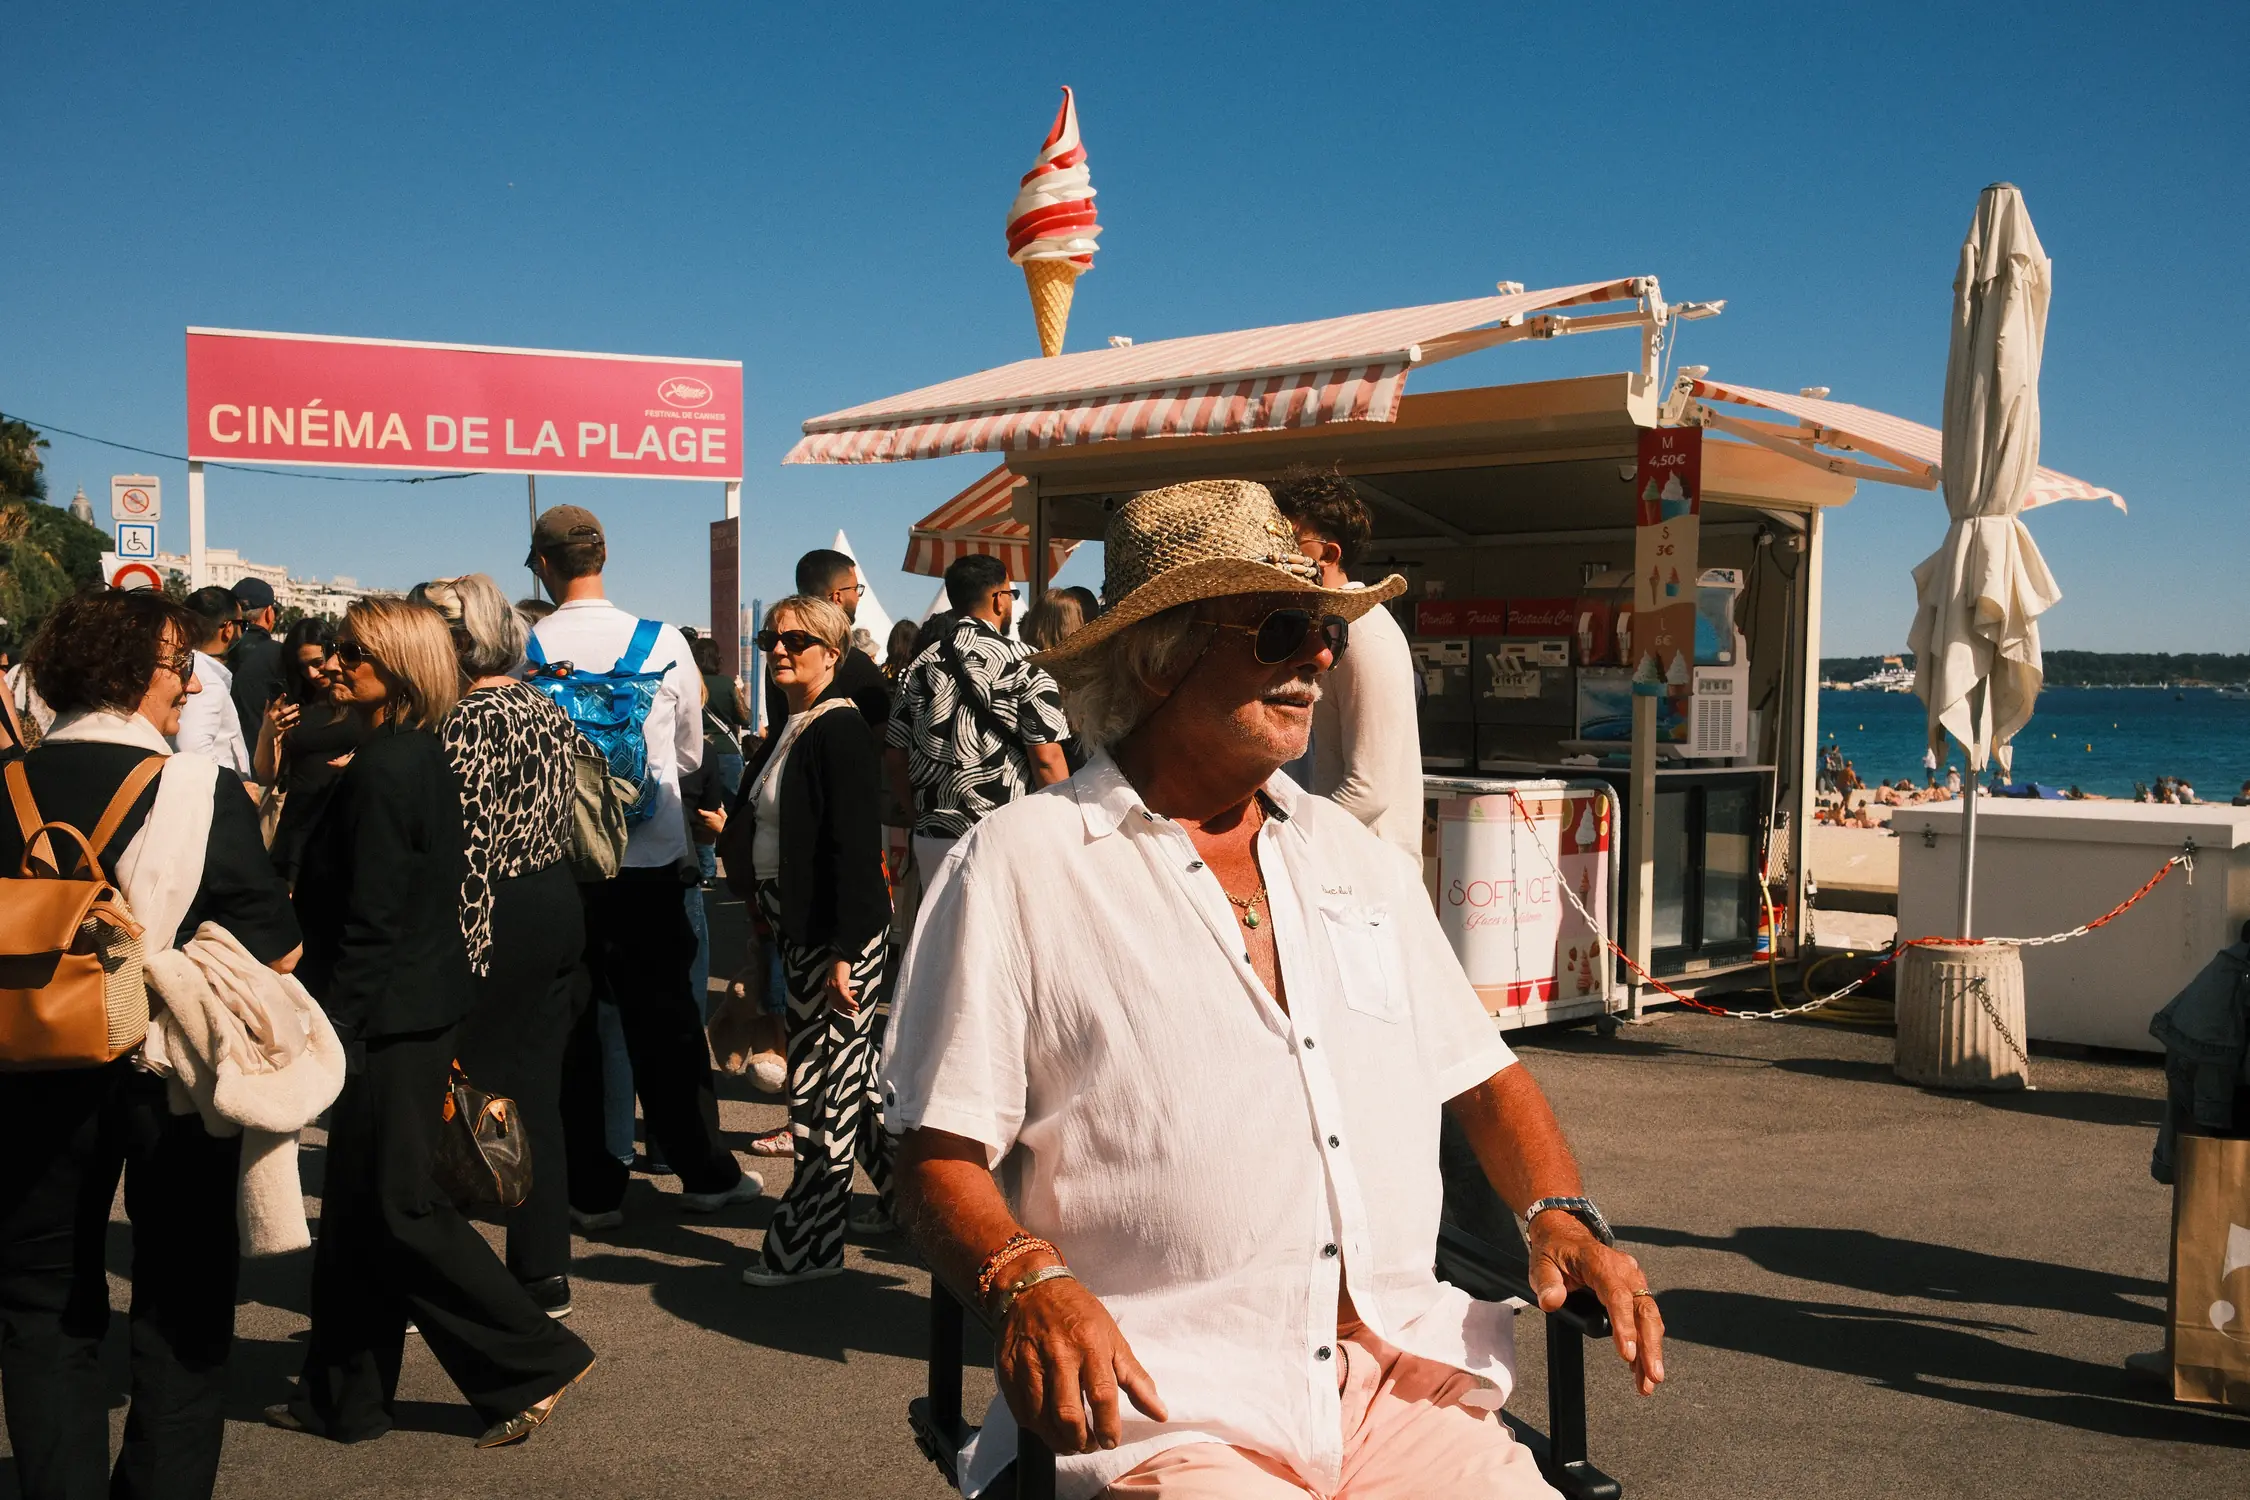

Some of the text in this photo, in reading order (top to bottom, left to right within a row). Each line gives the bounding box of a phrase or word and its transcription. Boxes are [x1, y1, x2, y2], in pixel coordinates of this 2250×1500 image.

[644, 408, 726, 421] FESTIVAL DE CANNES
[208, 398, 727, 464] CINÉMA DE LA PLAGE
[1662, 436, 1674, 449] M
[1648, 453, 1687, 468] 4,50€
[1661, 526, 1670, 540] S
[1656, 544, 1675, 556] 3€
[1466, 610, 1501, 626] Fraise
[1508, 609, 1552, 626] Pistache
[1525, 876, 1552, 904] ICE
